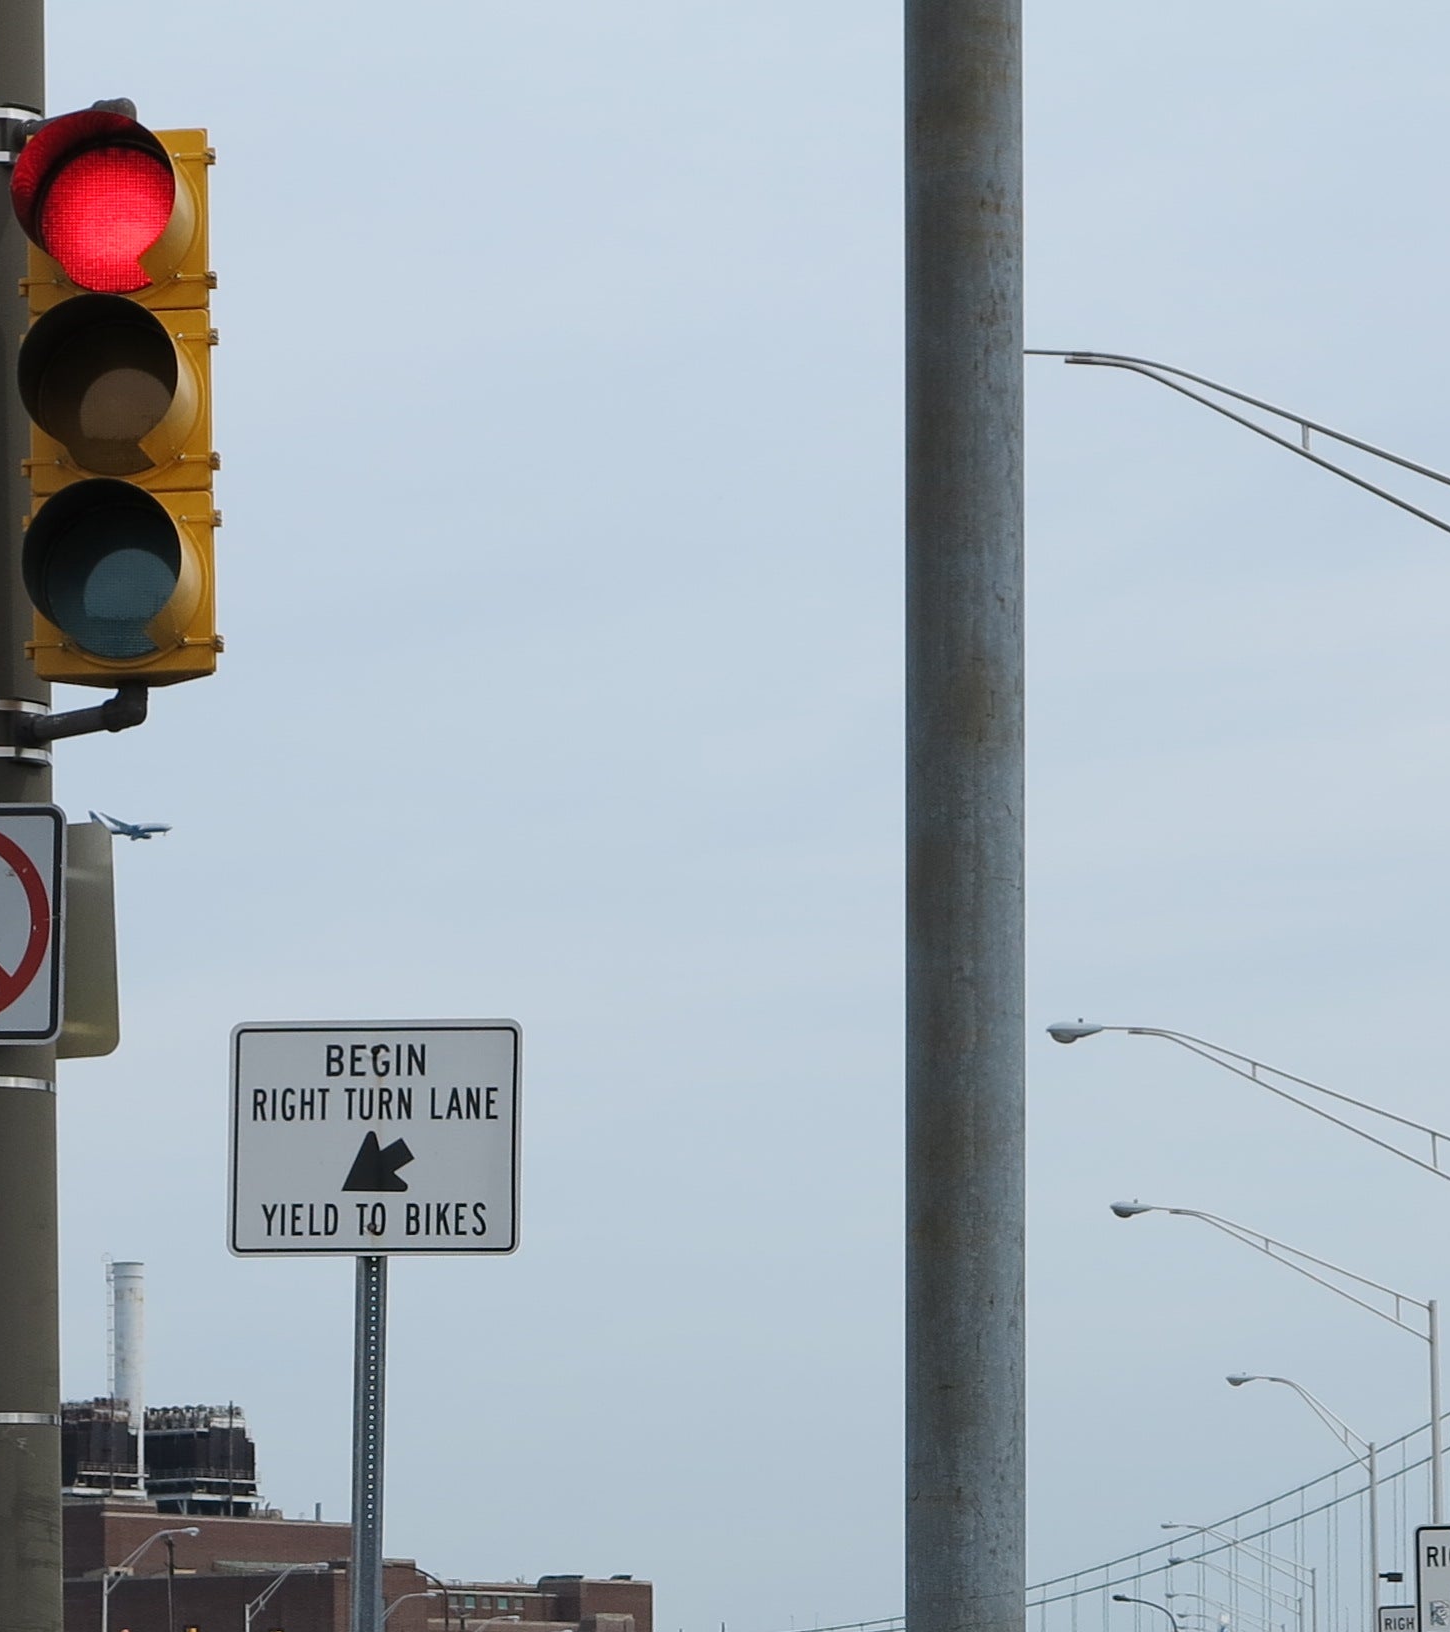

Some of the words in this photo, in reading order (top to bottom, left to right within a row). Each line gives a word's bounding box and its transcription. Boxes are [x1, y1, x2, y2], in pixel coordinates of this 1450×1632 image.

[325, 1043, 427, 1077] BEGIN
[252, 1088, 330, 1121] RIGHT
[344, 1087, 413, 1120] TURN
[430, 1087, 499, 1120] LANE
[261, 1203, 339, 1236] YIELD
[355, 1203, 387, 1236] TO
[405, 1202, 488, 1236] BIKES
[1384, 1617, 1415, 1631] RIGH
